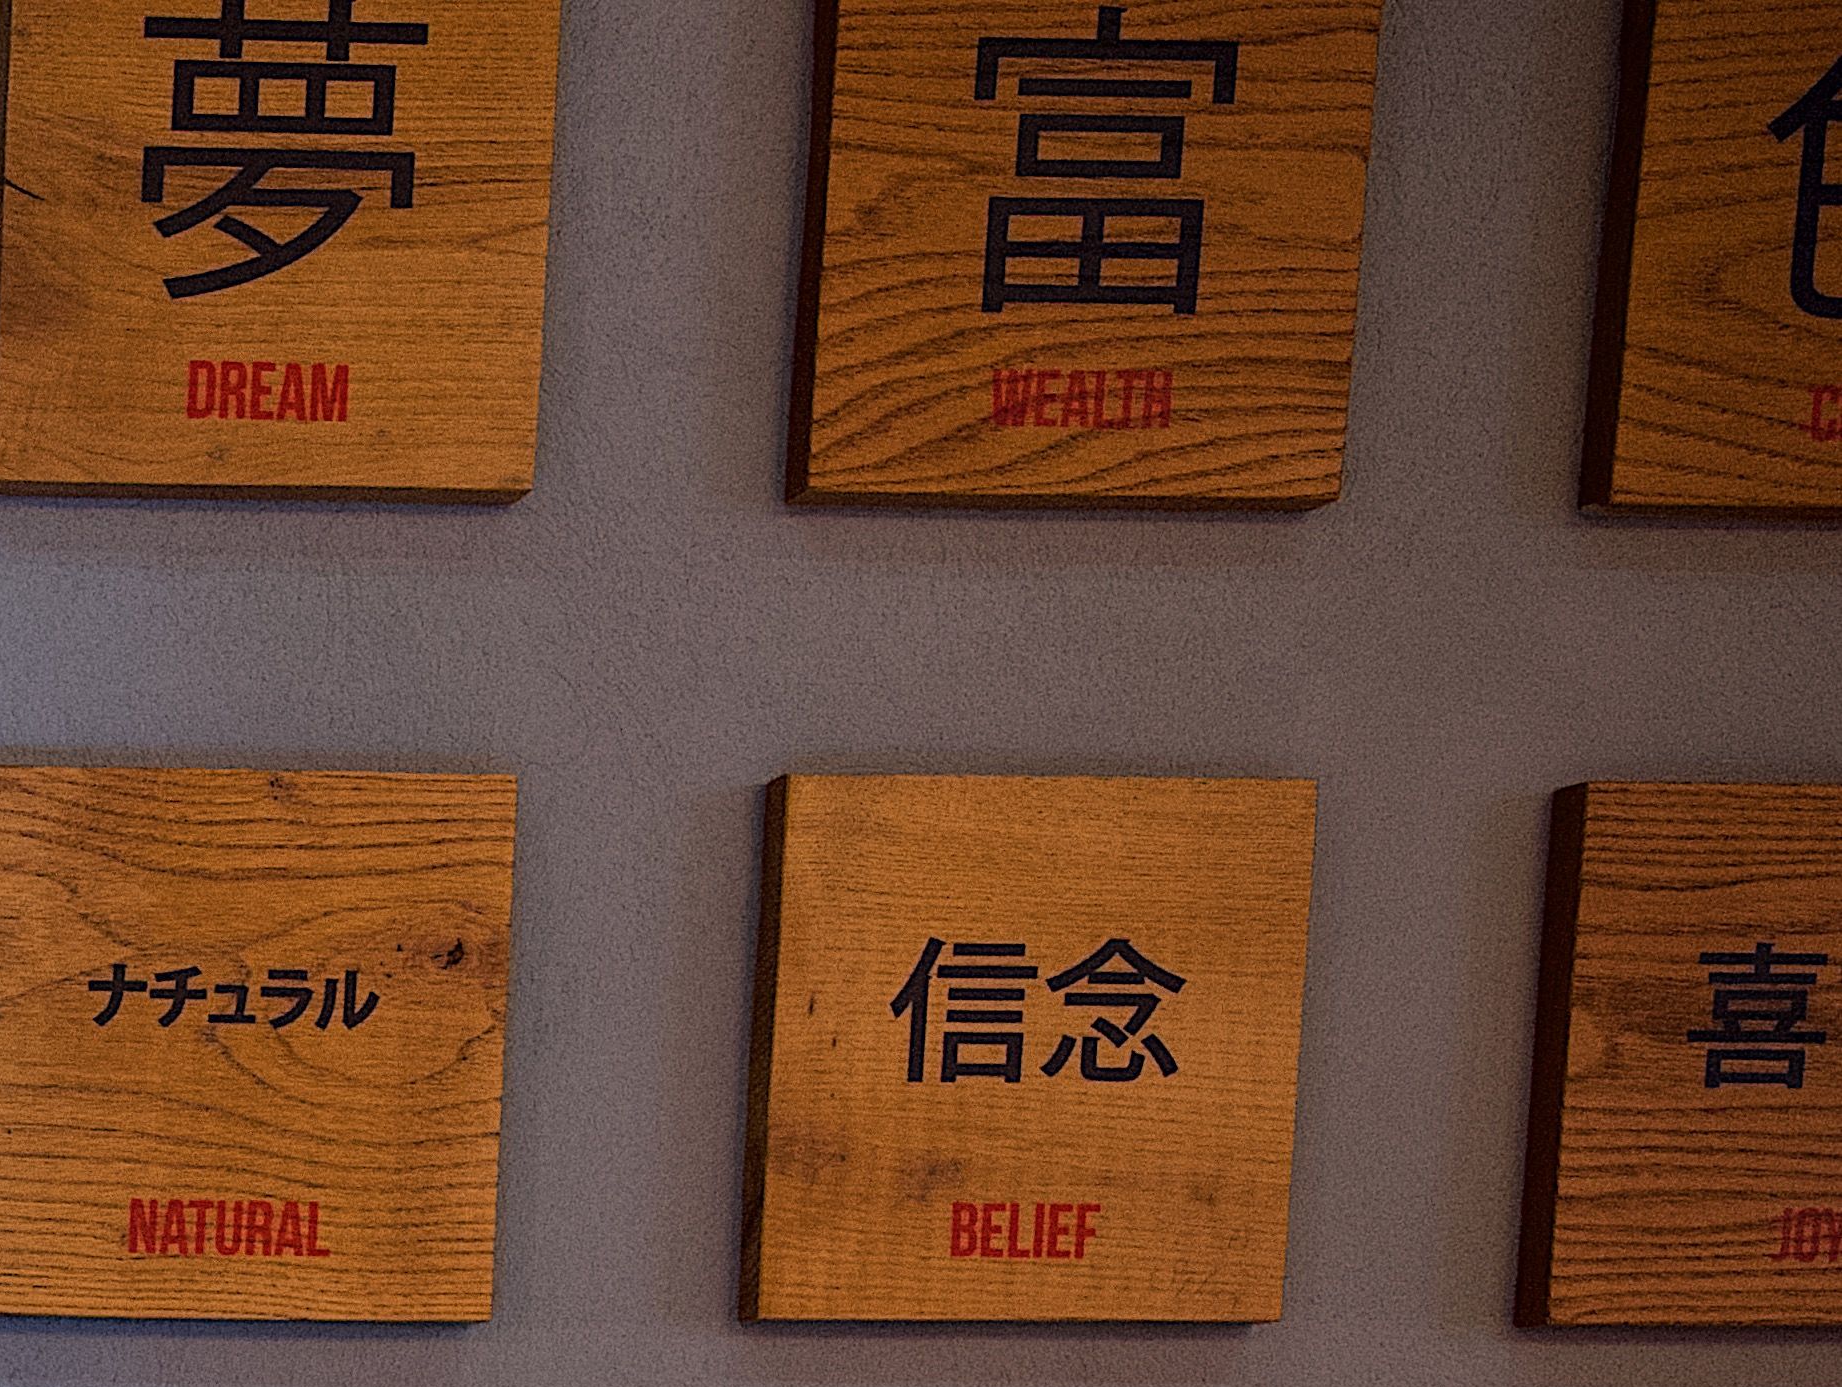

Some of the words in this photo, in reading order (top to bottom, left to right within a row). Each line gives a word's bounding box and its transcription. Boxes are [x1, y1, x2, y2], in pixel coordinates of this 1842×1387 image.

[141, 0, 429, 298] 夢
[975, 6, 1239, 314] 富
[186, 361, 348, 421] DREAM
[990, 370, 1172, 430] WEALTH
[88, 963, 378, 1028] ナチュラル
[892, 939, 1184, 1082] 信念
[1687, 943, 1829, 1088] 喜
[128, 1199, 329, 1256] NATURAL
[951, 1202, 1099, 1258] BELIEF
